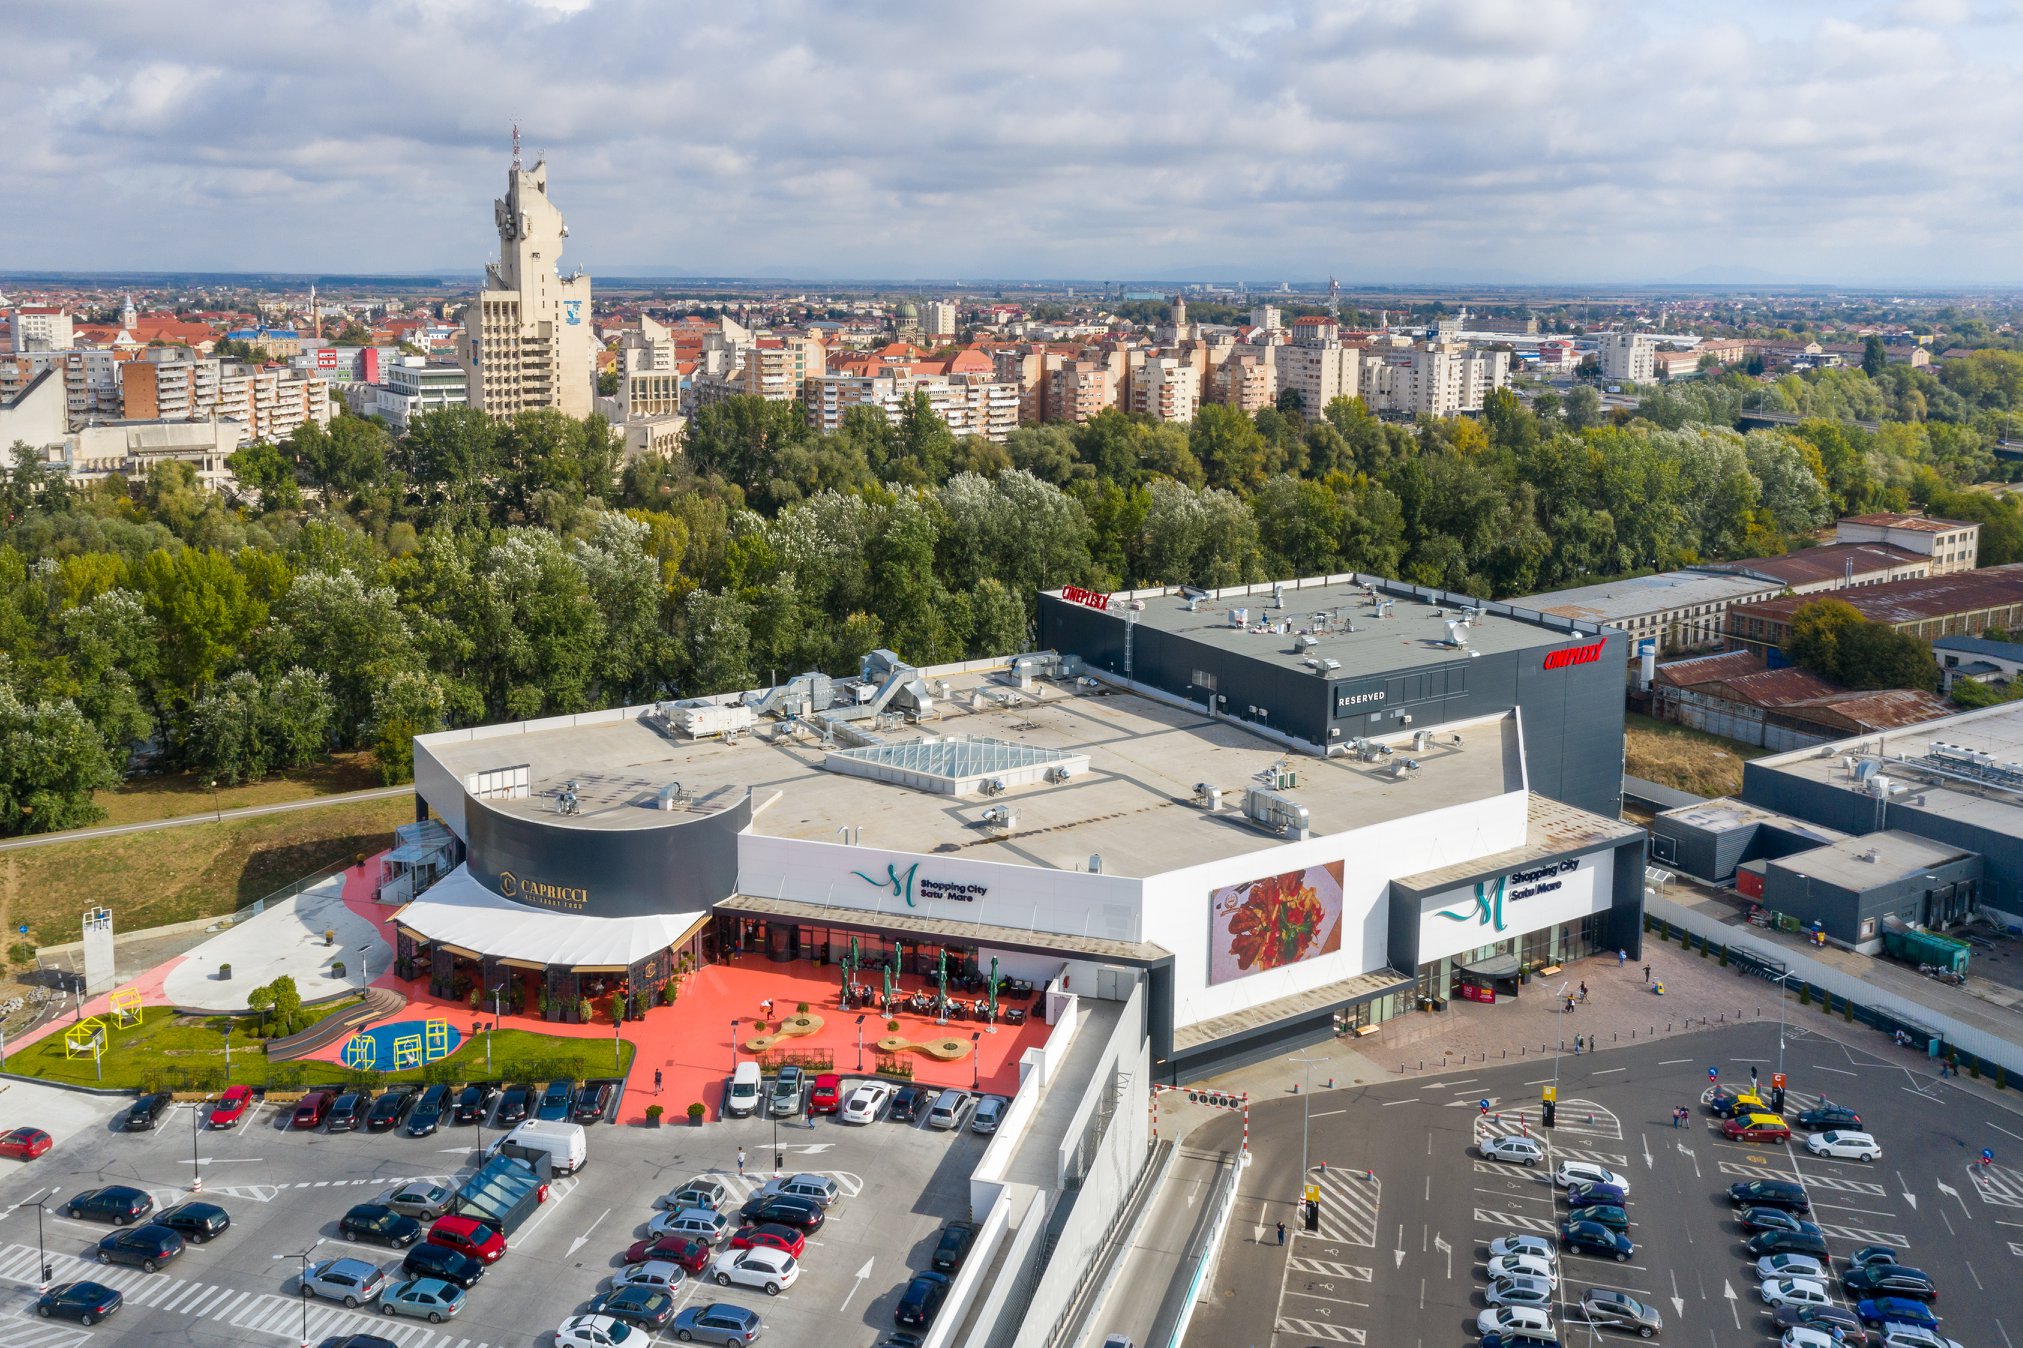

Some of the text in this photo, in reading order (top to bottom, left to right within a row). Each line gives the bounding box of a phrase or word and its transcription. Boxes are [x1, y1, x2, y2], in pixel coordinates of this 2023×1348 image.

[1062, 585, 1112, 610] CINEPLEXX
[1543, 636, 1607, 670] CINEPLEXX
[1339, 691, 1384, 706] RESERVED
[1510, 858, 1580, 885] Shopping City
[521, 879, 588, 903] CAPRICCI
[920, 889, 973, 902] Satu Mare
[921, 879, 987, 896] Shopping City
[1510, 880, 1562, 901] Satu Mare
[1774, 1073, 1782, 1082] C
